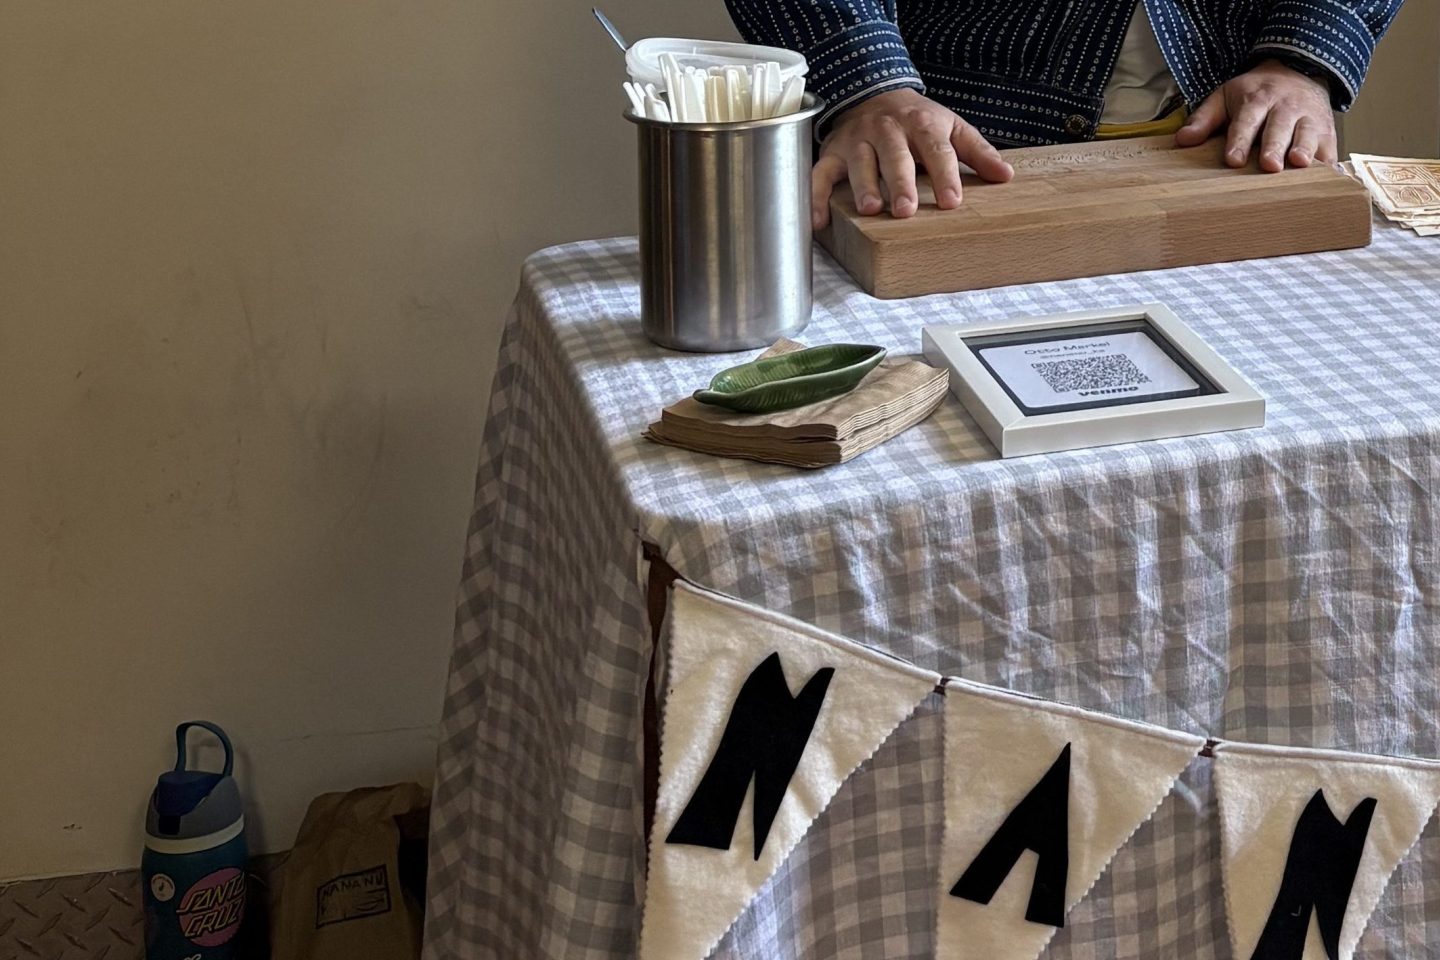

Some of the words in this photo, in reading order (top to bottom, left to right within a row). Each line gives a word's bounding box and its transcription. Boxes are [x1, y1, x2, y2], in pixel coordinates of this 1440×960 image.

[1077, 386, 1139, 397] venmo
[175, 870, 247, 914] SANTA
[183, 898, 240, 939] CRUZ
